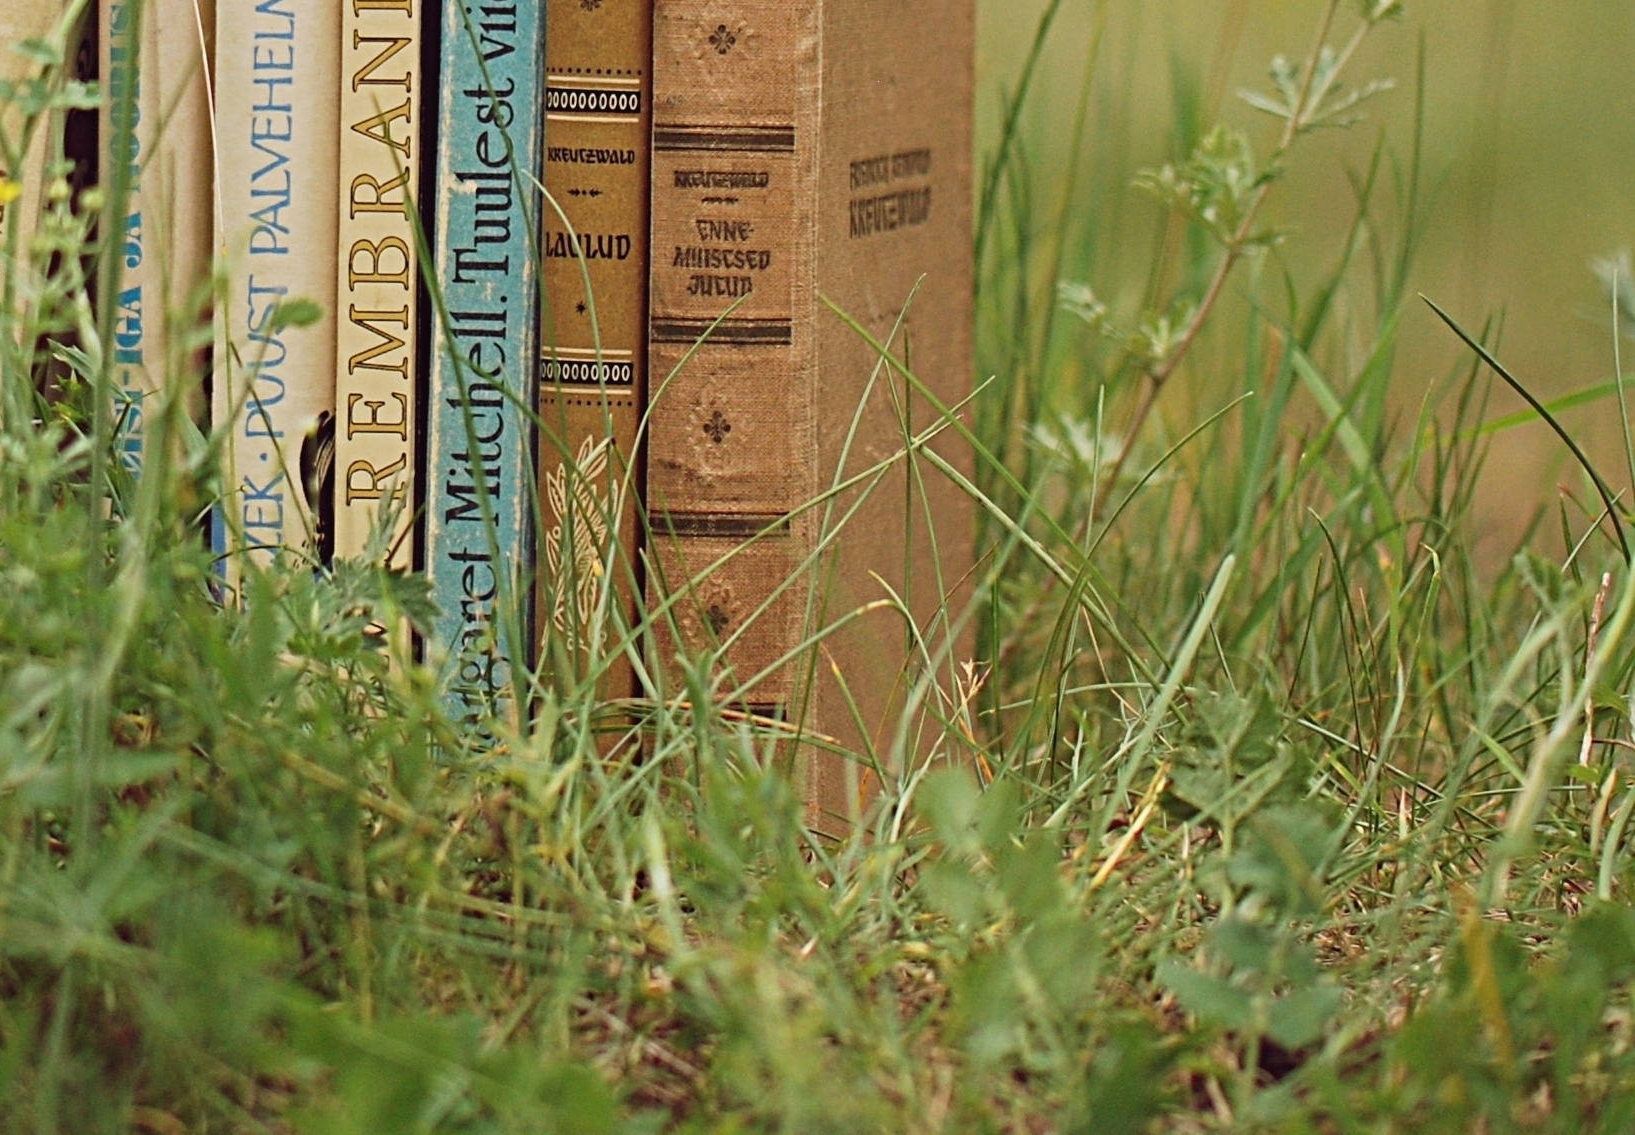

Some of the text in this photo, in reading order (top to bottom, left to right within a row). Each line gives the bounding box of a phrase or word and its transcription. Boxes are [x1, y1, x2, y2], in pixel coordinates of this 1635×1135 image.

[452, 78, 515, 284] Tuulest
[547, 146, 635, 165] KREUTZWALD
[546, 231, 631, 261] LAULUD
[245, 274, 288, 439] PUUST
[448, 546, 511, 754] argaret
